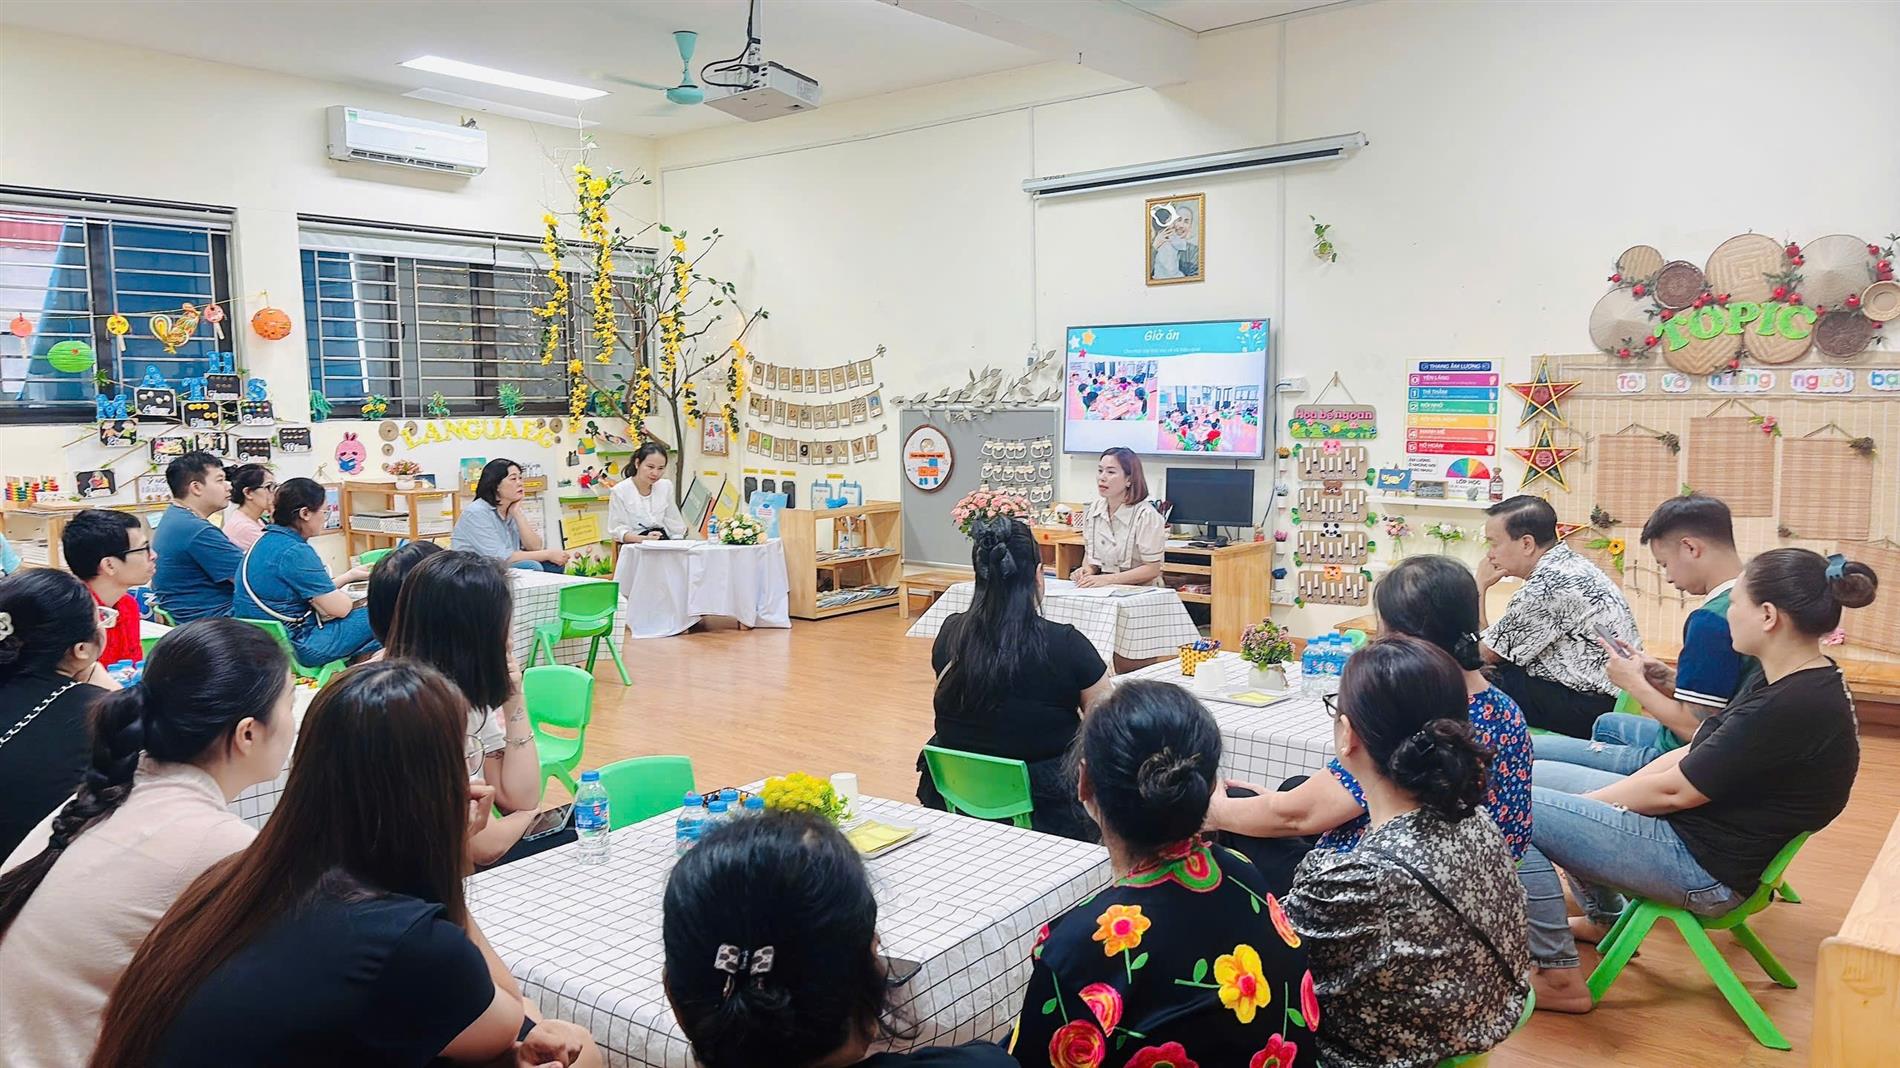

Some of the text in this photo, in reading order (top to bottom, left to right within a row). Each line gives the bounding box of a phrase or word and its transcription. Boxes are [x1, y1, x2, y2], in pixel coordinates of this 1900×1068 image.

[1654, 302, 1818, 352] TOPIC
[1144, 329, 1165, 341] Giờ
[1296, 409, 1317, 419] Hoa
[1335, 411, 1373, 422] ngoan
